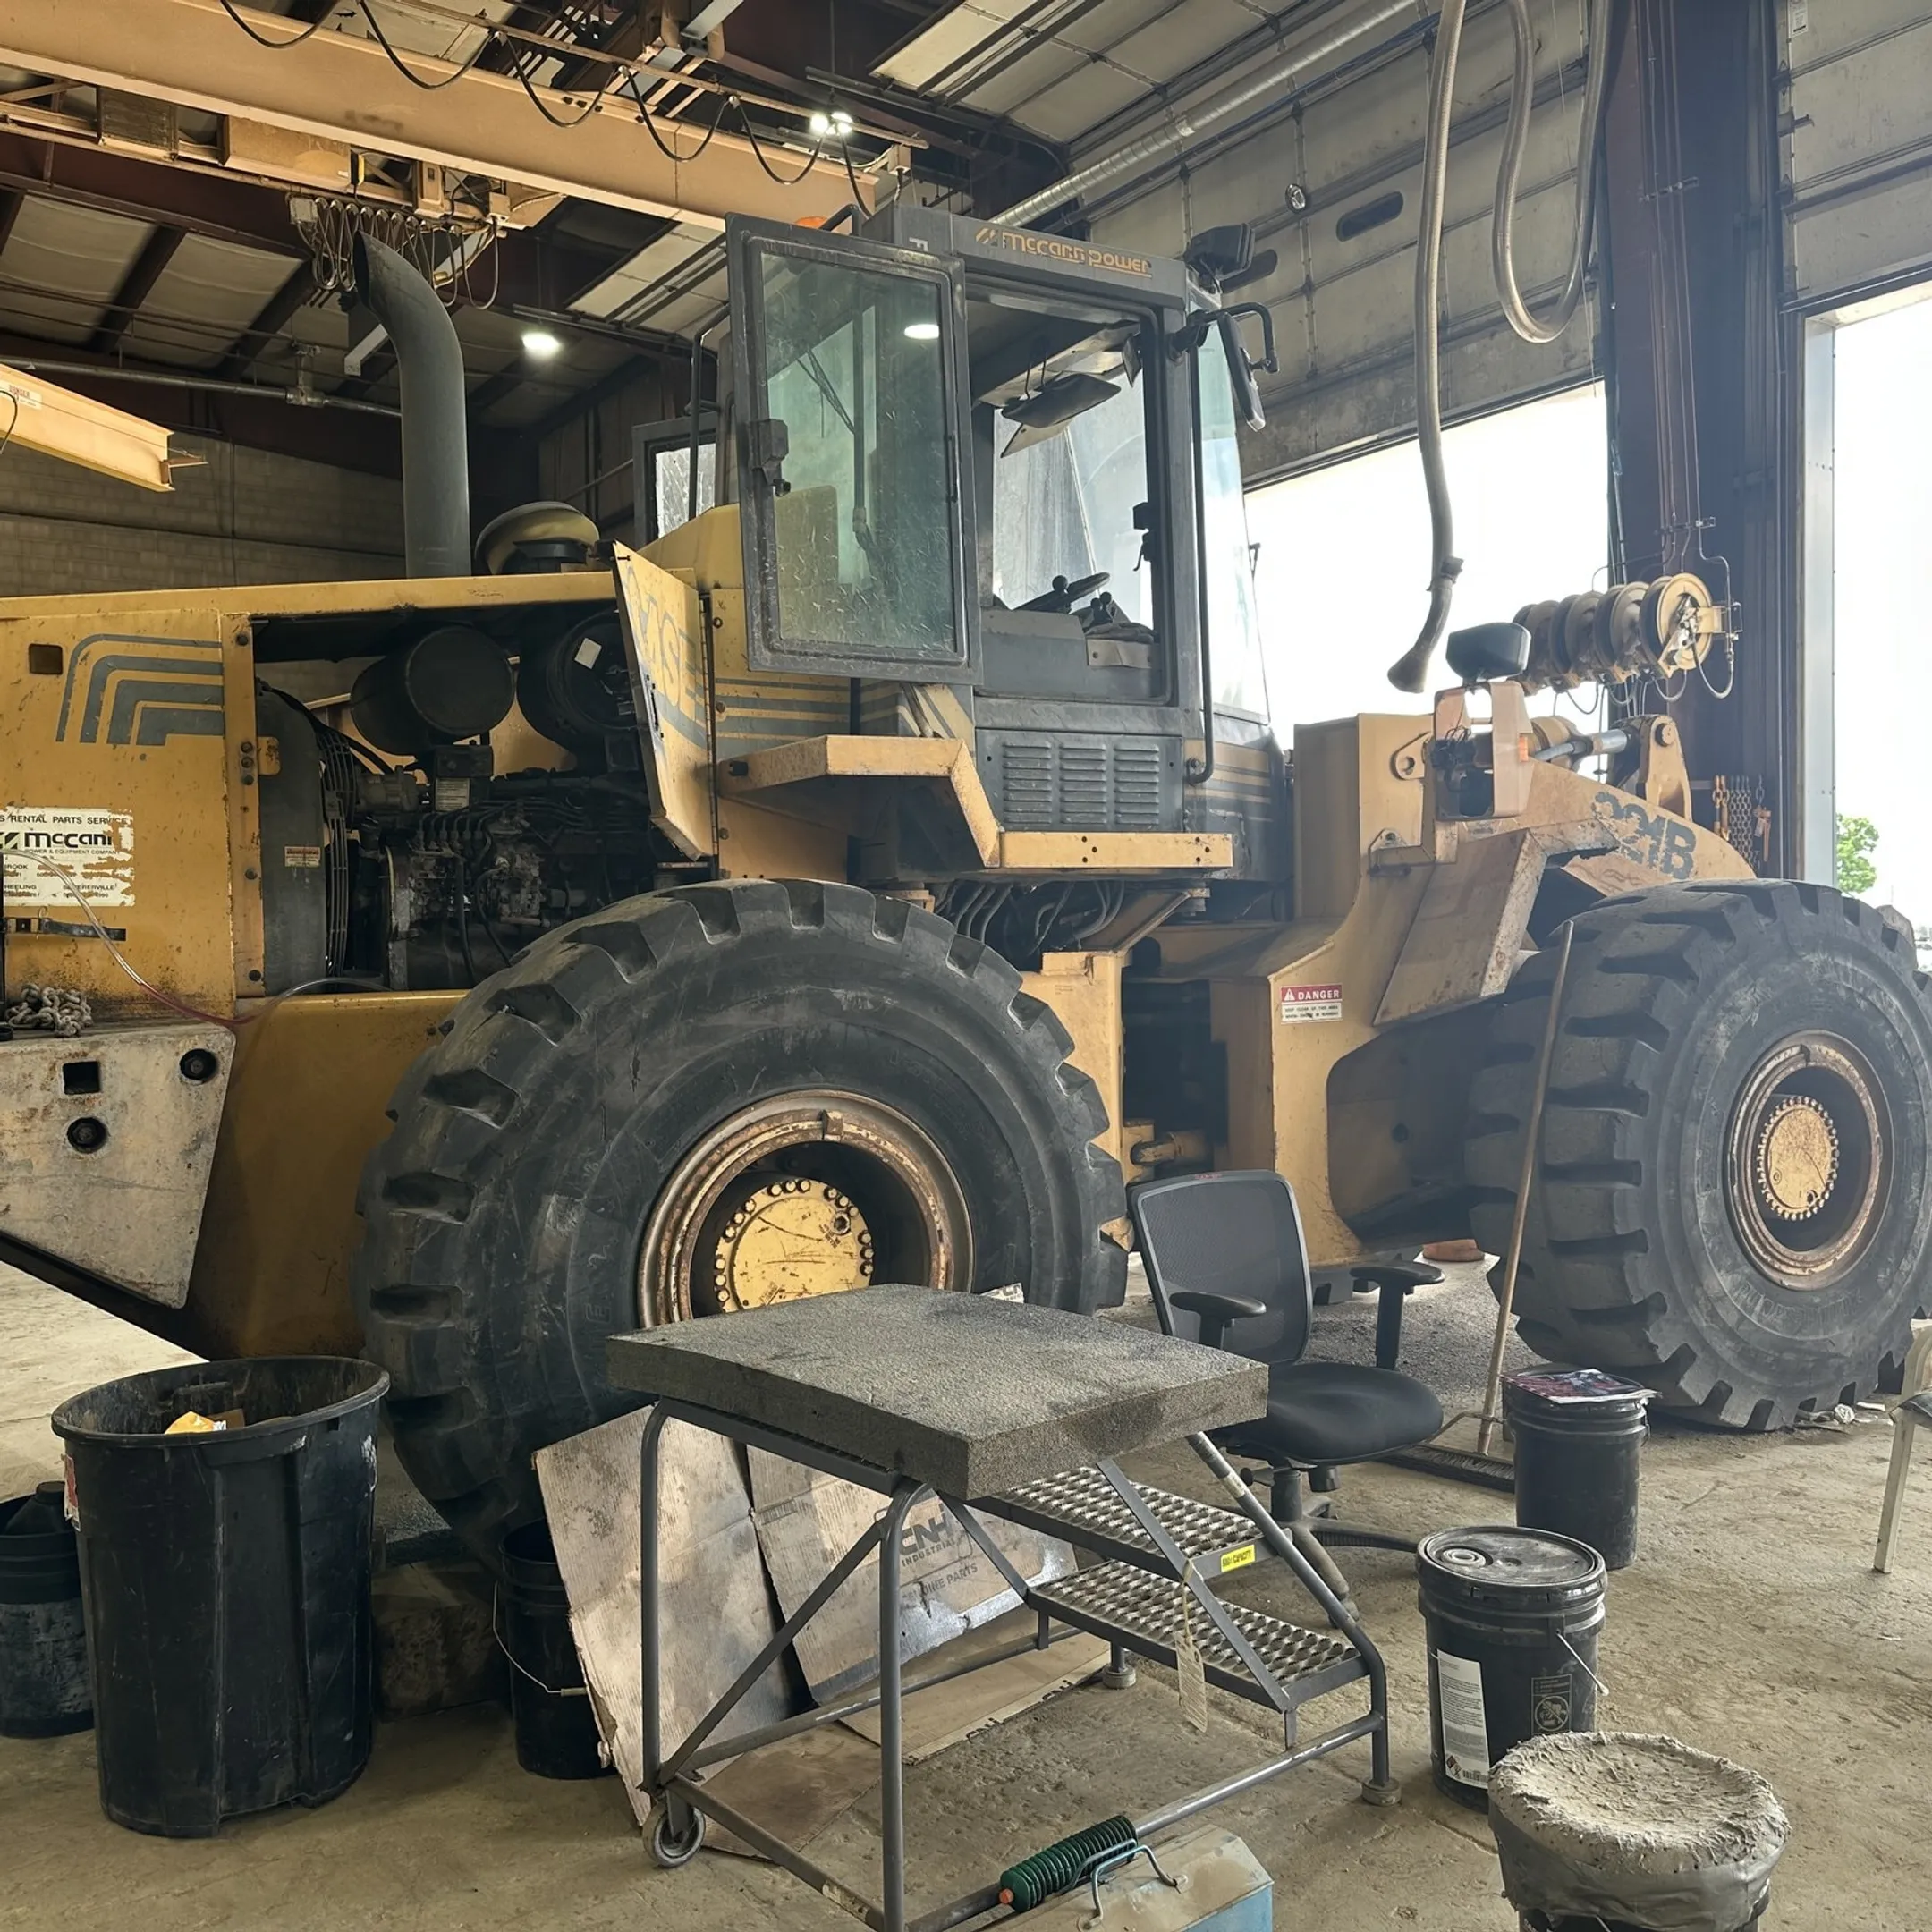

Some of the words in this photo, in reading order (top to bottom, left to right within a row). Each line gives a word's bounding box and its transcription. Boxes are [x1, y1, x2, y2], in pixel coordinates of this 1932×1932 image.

[11, 815, 47, 823] RENTAL
[52, 816, 82, 824] PARTS
[1298, 990, 1339, 1000] DANGER
[899, 1513, 953, 1556] CNH
[902, 1539, 956, 1566] INDUSTRIAL
[946, 1563, 979, 1585] PARTS
